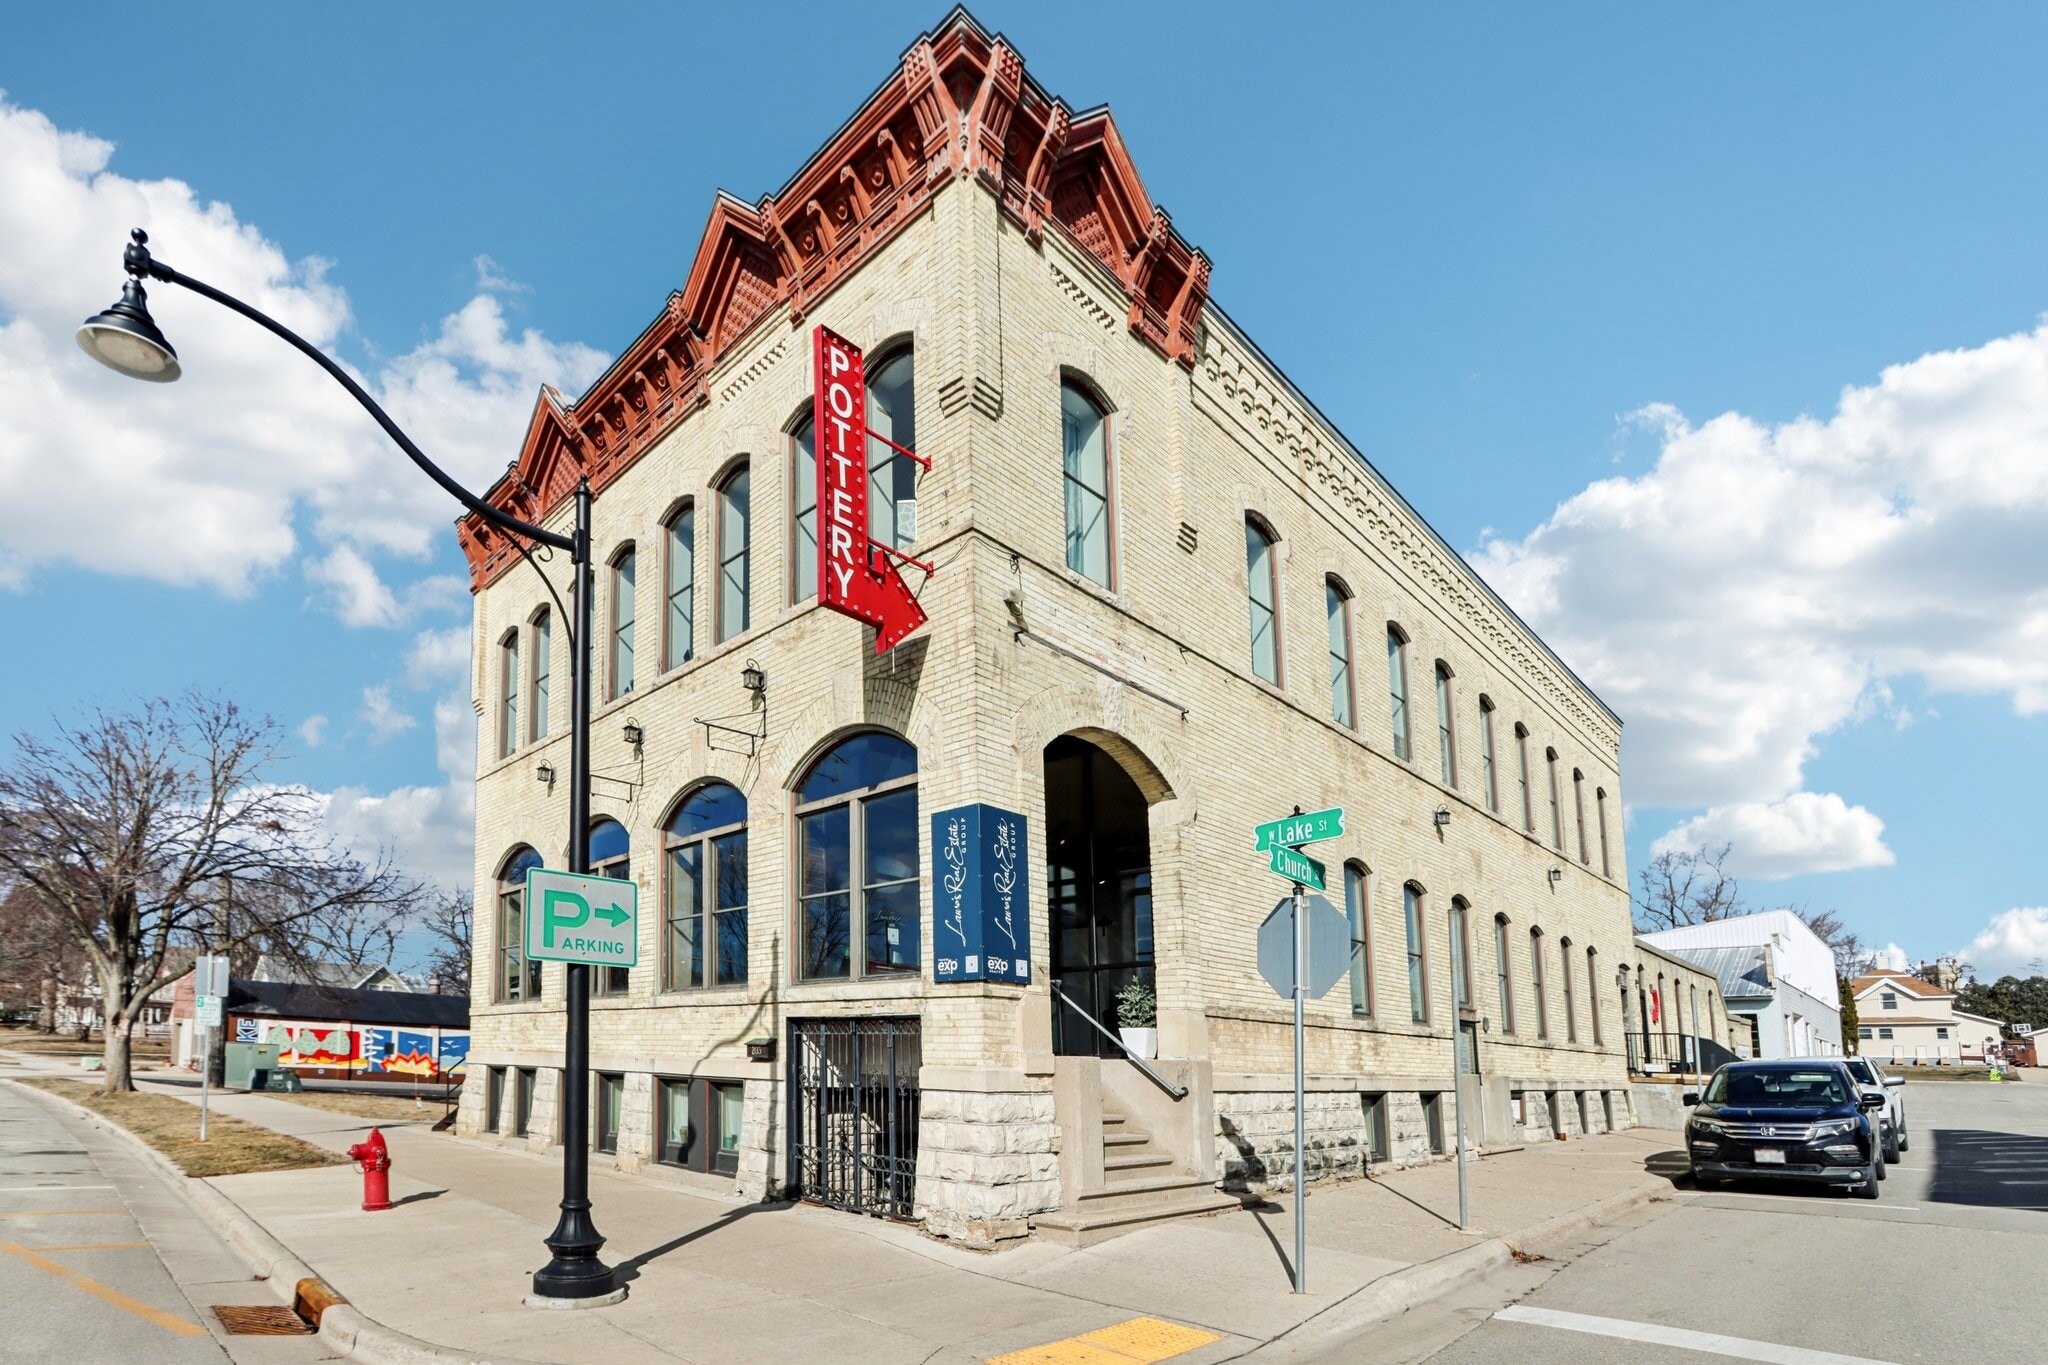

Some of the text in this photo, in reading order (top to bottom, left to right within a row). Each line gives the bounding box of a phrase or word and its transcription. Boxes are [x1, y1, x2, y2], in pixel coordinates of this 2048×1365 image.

[829, 345, 854, 599] POTTERY
[1268, 819, 1327, 844] W Lake St
[944, 864, 967, 894] Real
[993, 864, 1016, 894] Real
[1277, 850, 1312, 883] Church
